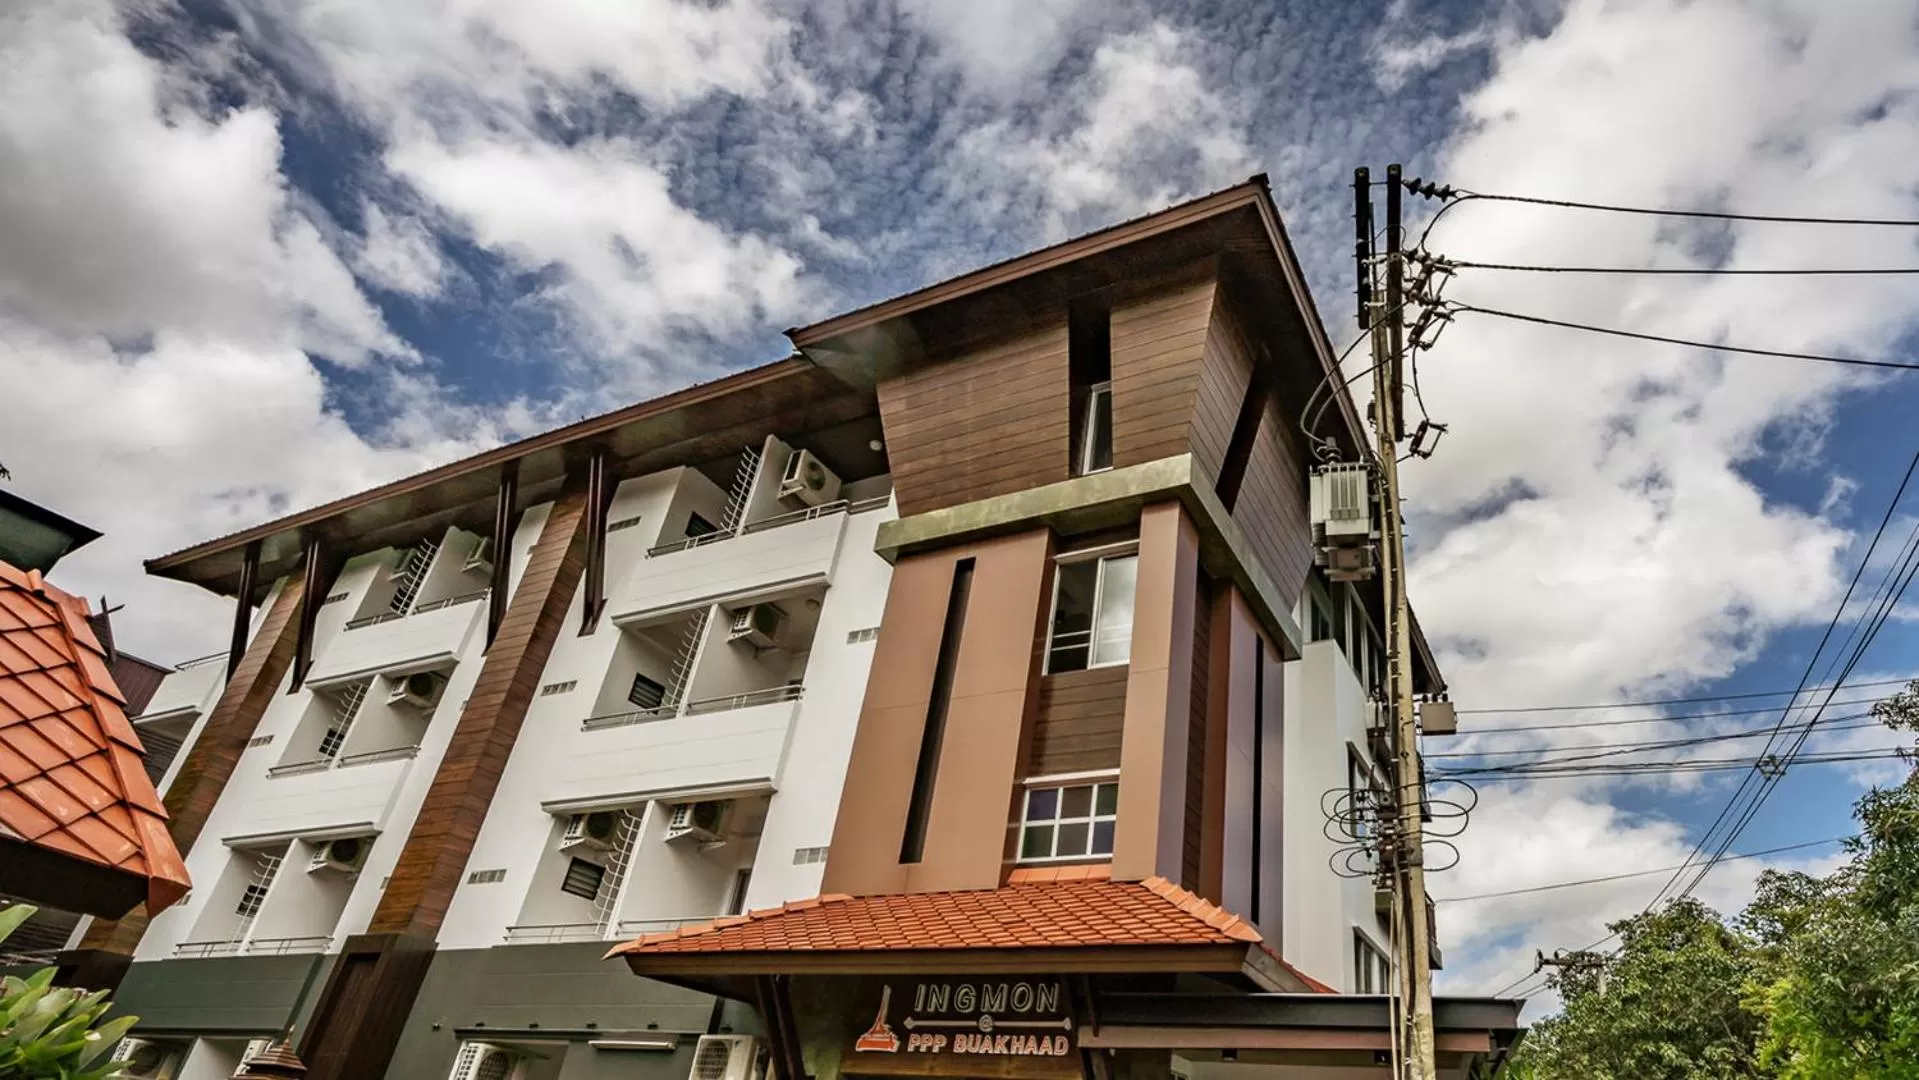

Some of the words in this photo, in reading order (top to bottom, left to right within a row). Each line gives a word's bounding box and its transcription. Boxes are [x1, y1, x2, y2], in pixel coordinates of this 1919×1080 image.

[914, 982, 1060, 1013] INGMON
[978, 1014, 994, 1032] @
[907, 1033, 947, 1053] PPP
[953, 1034, 1069, 1056] BUAKHAAD
